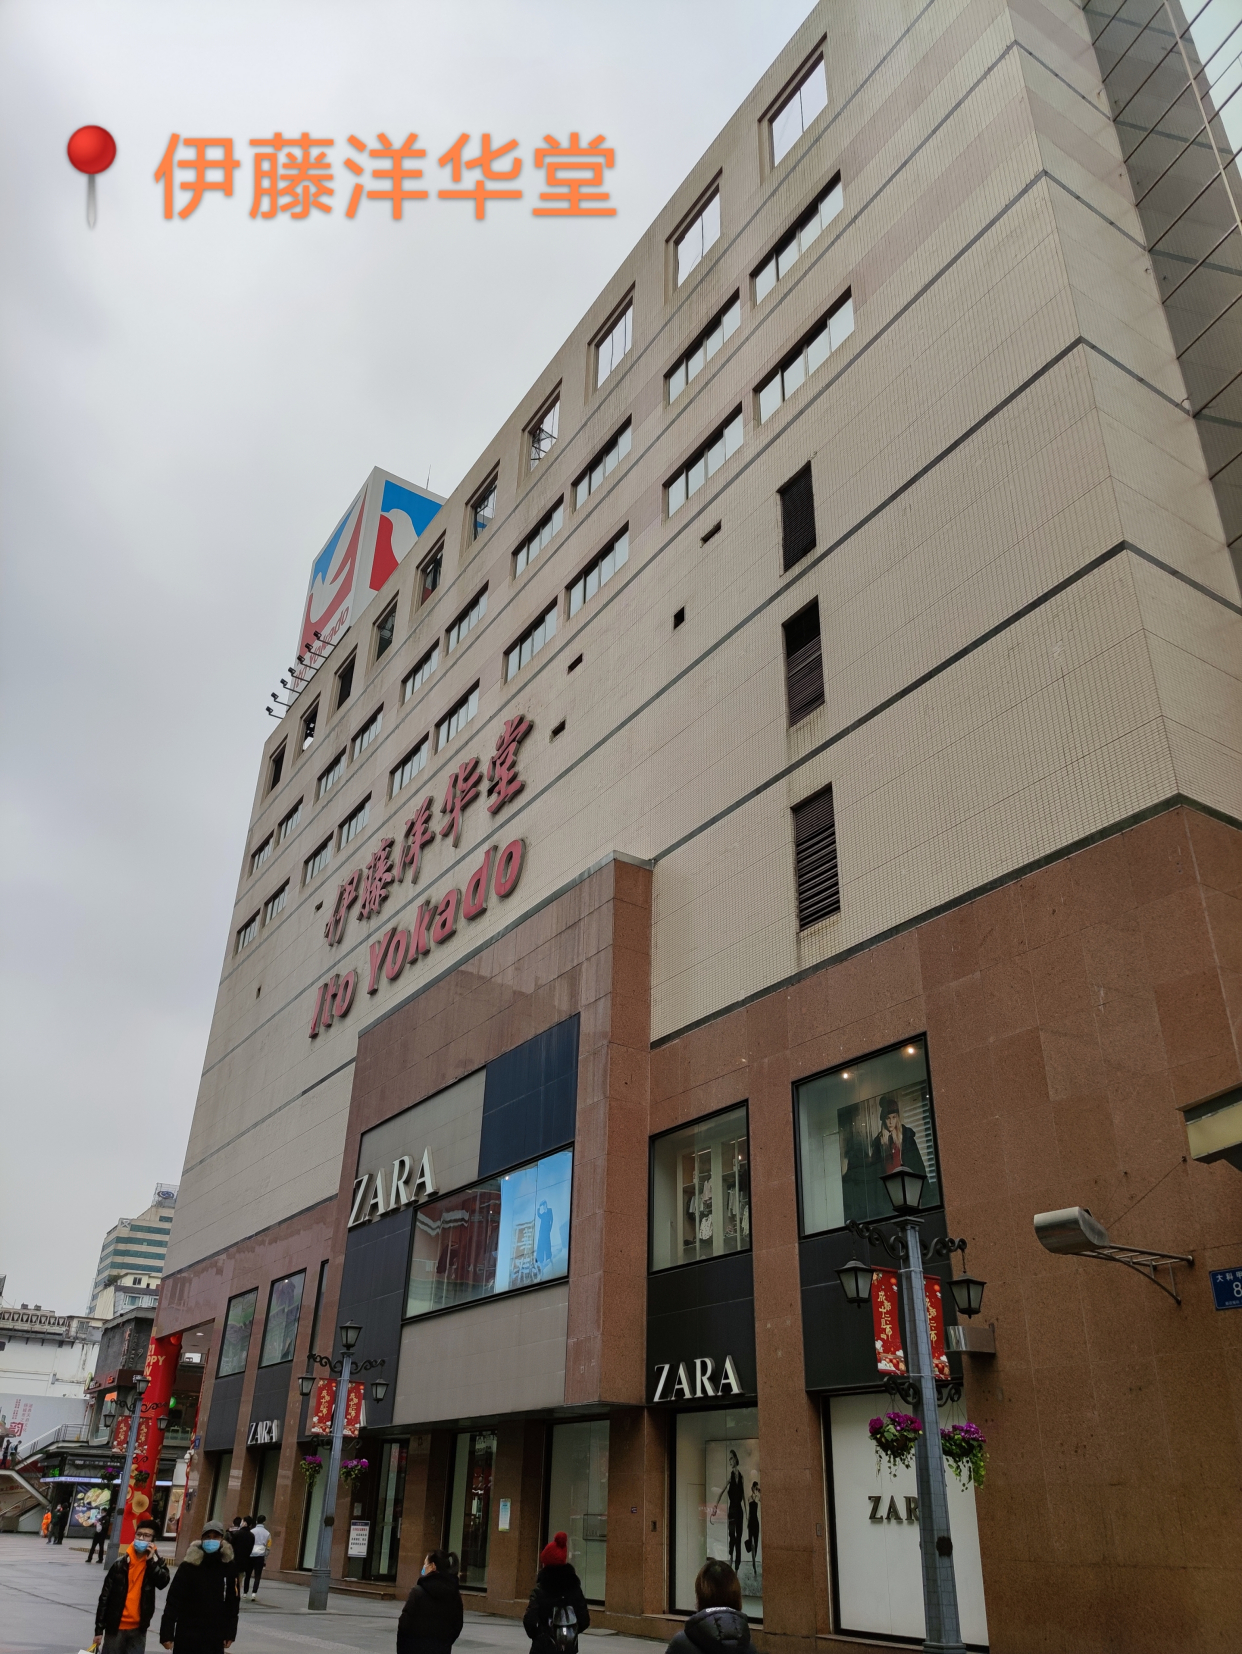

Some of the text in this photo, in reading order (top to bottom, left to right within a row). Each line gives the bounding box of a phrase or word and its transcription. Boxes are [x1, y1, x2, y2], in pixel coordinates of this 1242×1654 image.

[323, 713, 535, 947] 伊藤洋华堂
[308, 839, 527, 1039] Ito Yokado
[347, 1146, 438, 1228] ZARA
[653, 1354, 743, 1402] ZARA
[247, 1419, 279, 1445] ZARA
[868, 1495, 919, 1522] ZAR
